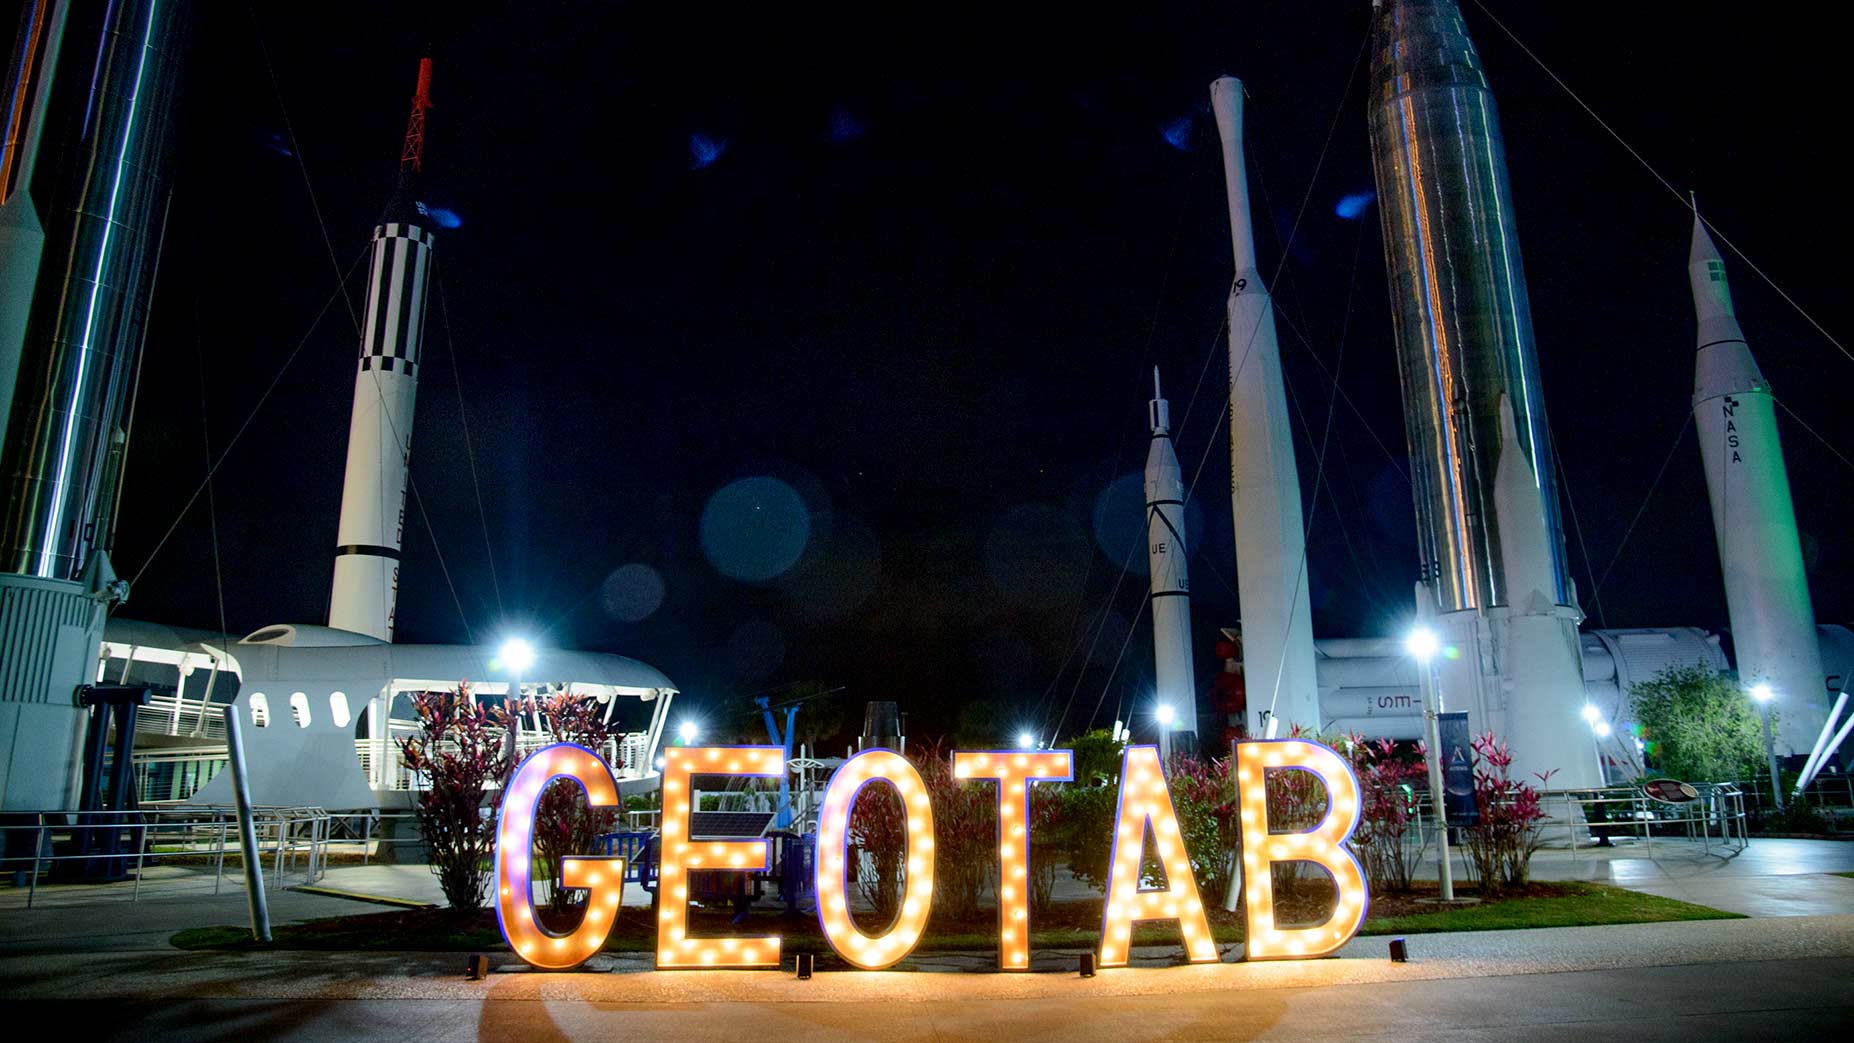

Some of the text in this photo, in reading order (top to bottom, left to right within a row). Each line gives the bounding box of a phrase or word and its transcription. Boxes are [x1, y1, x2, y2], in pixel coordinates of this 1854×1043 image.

[1722, 404, 1742, 464] NASA
[1152, 543, 1166, 554] UE
[494, 739, 1369, 971] GEOTAB
